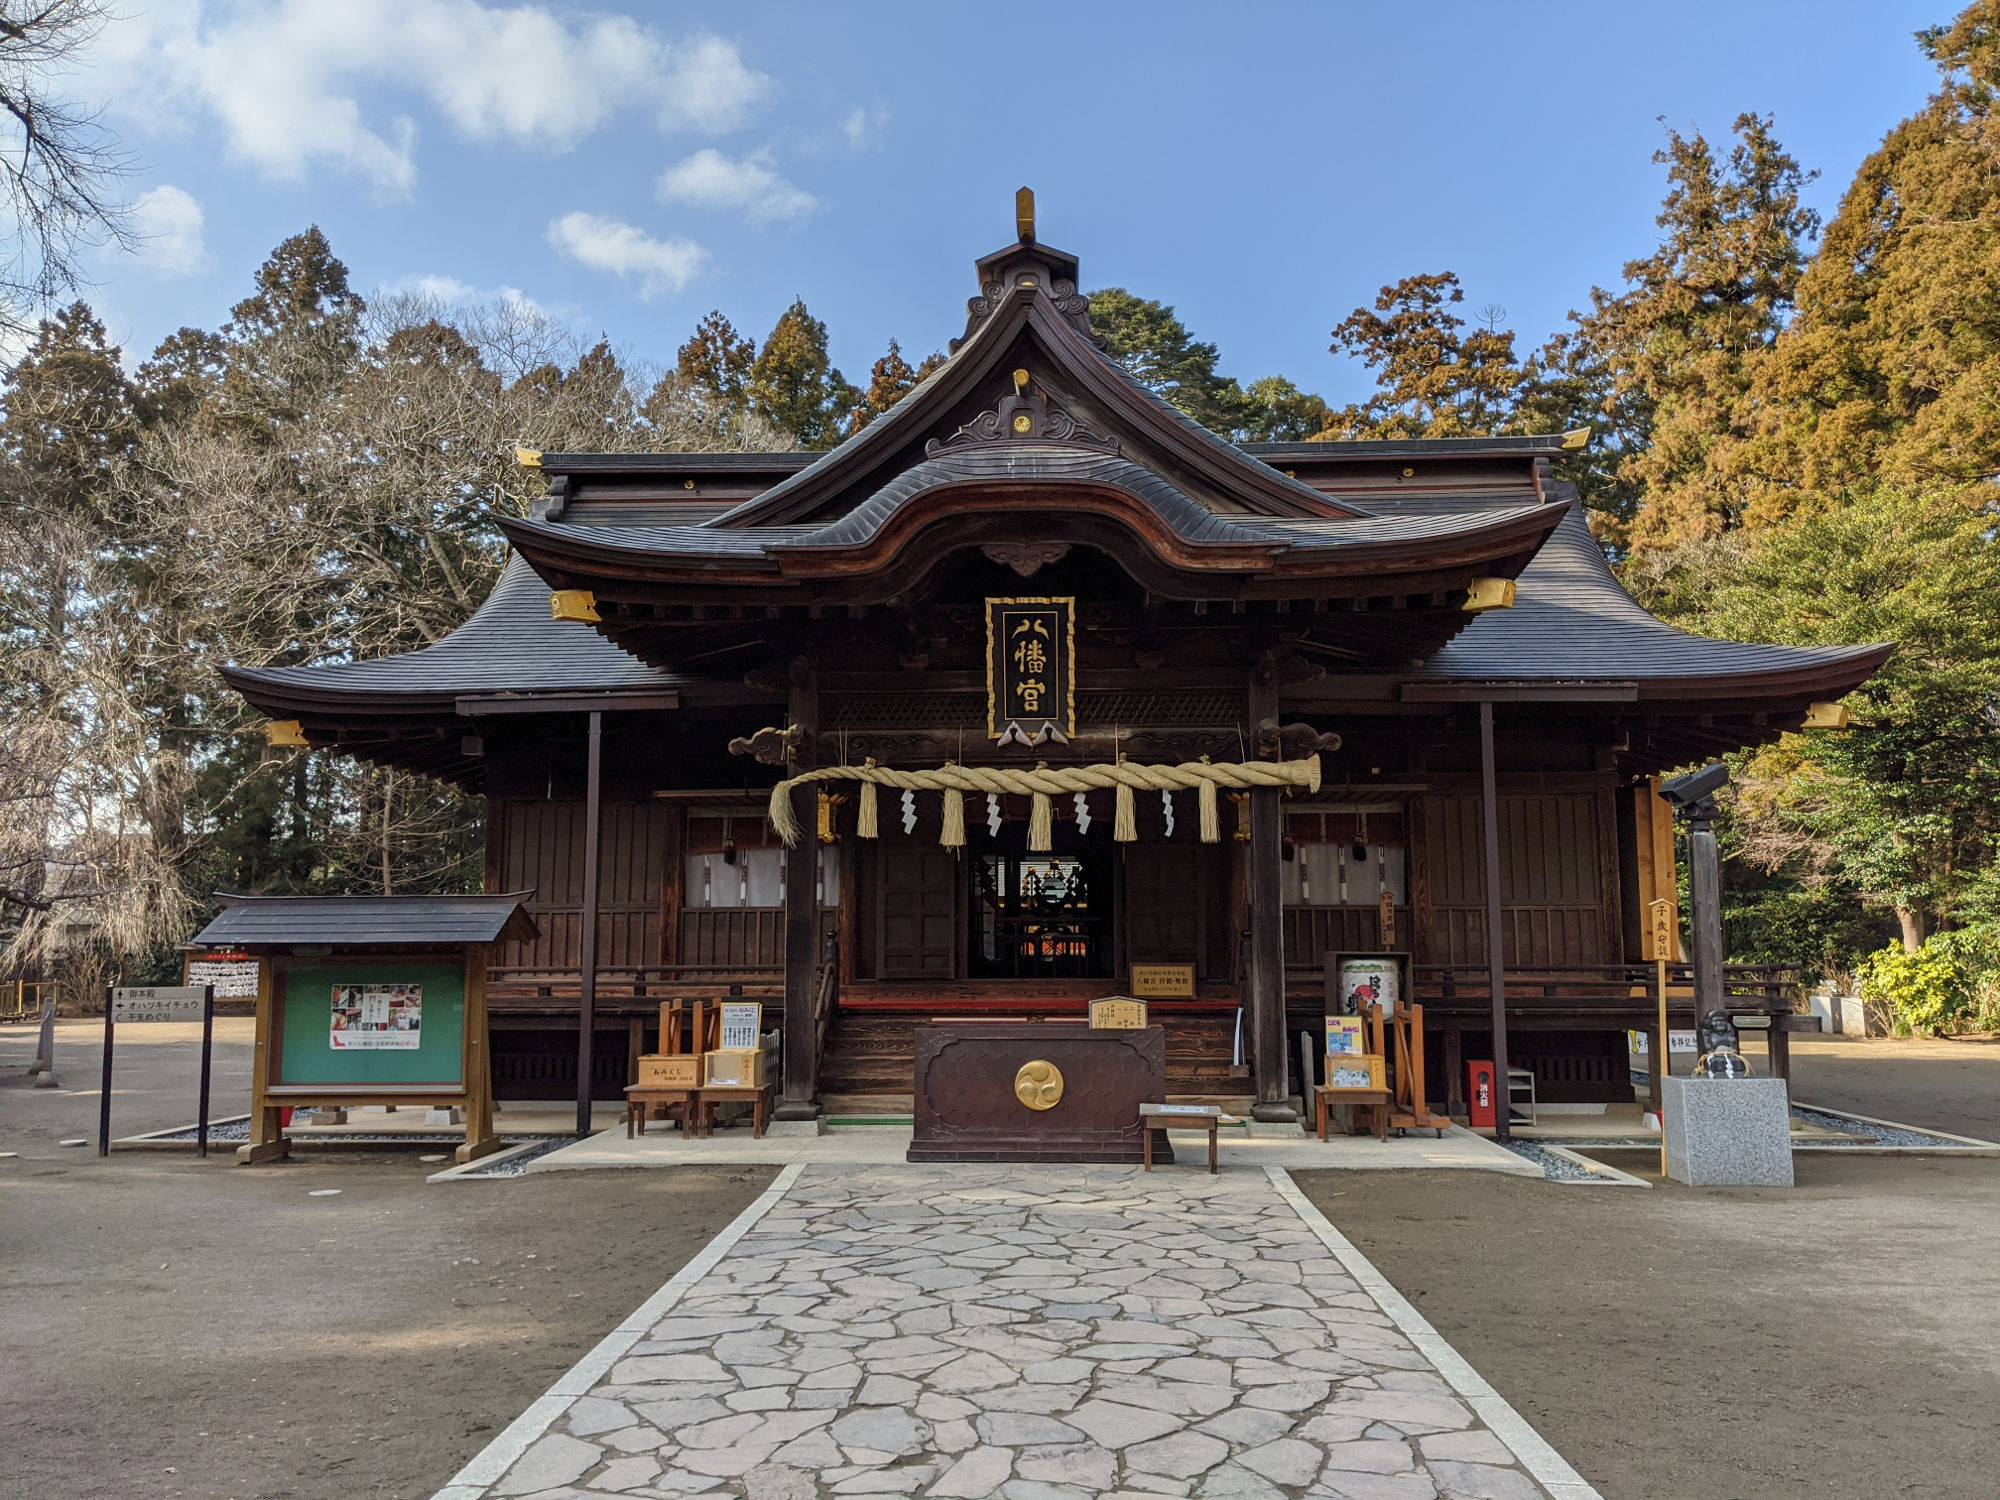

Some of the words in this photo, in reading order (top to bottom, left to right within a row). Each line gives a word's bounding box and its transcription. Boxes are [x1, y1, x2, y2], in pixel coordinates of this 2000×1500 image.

[1012, 618, 1049, 712] 八幡宮
[129, 989, 156, 999] 御本殿
[128, 1000, 199, 1010] オハツキイチョウ
[128, 1013, 170, 1022] 干支めぐり
[653, 1067, 682, 1076] おみくじ
[1479, 1083, 1489, 1108] 消火器
